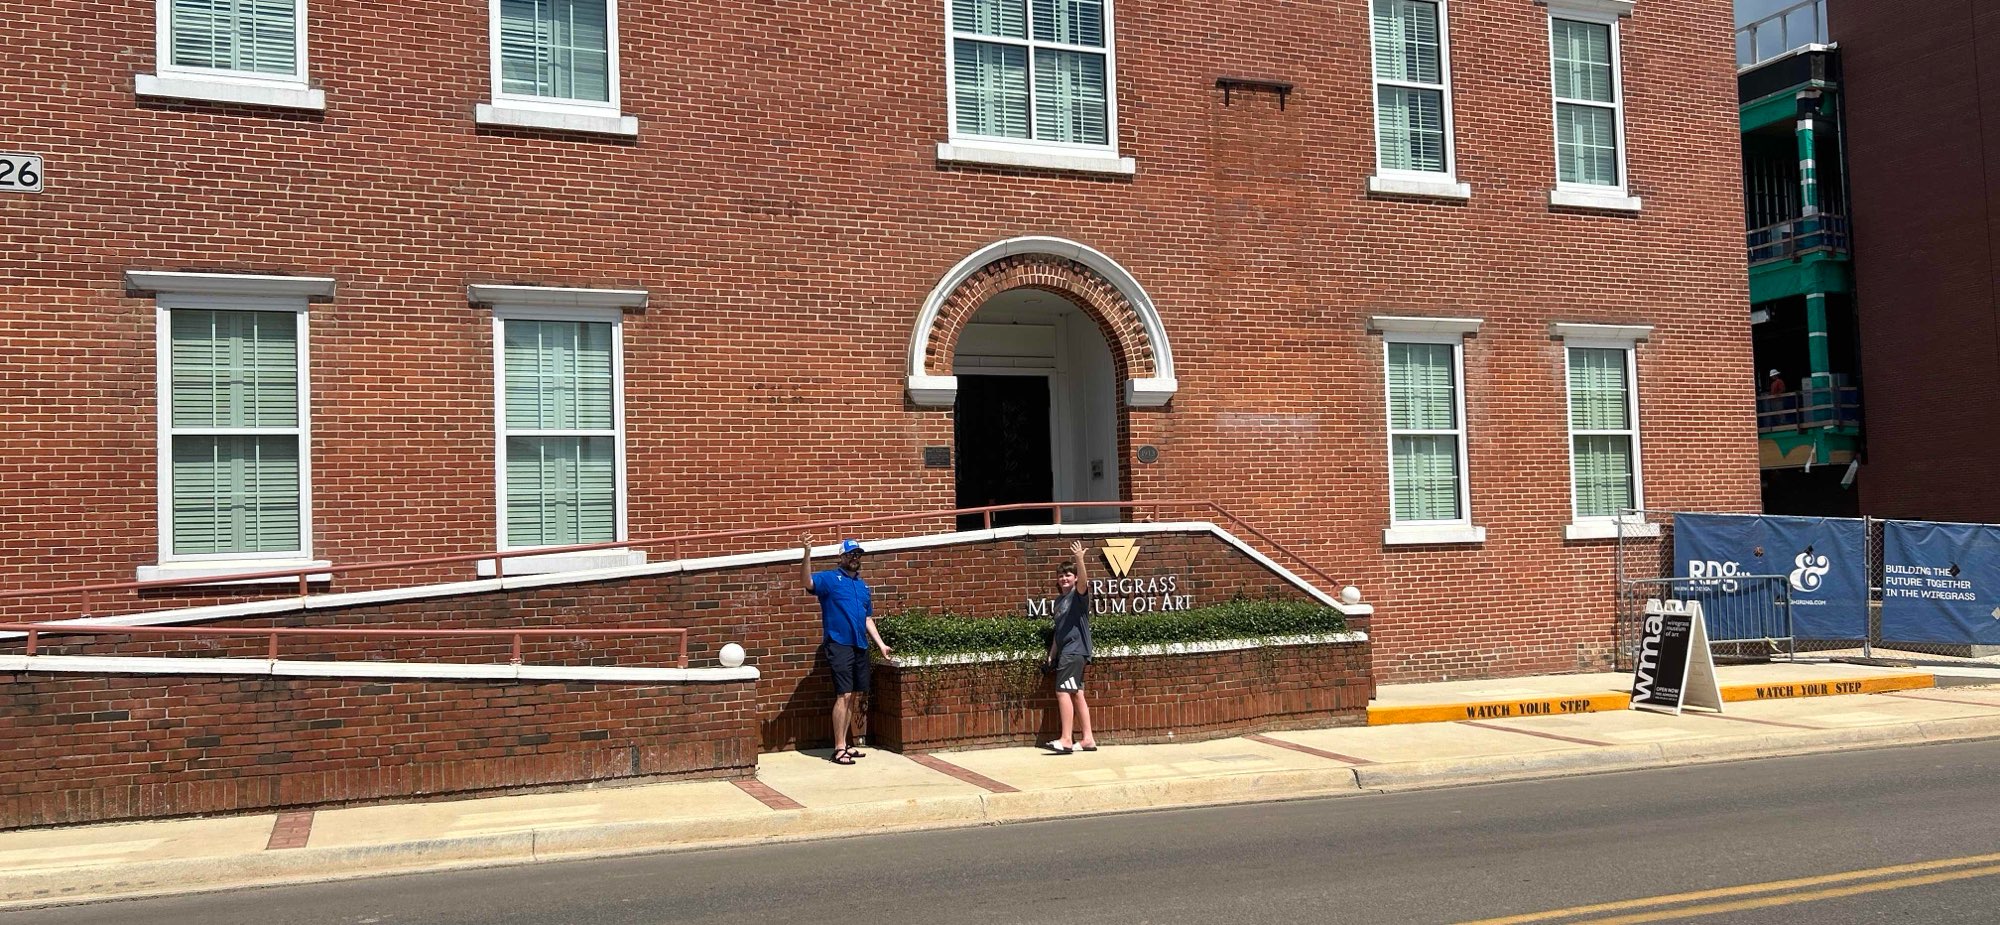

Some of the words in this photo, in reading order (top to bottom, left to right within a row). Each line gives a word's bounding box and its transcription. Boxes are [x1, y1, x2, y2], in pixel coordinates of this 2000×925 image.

[0, 159, 39, 187] 26
[1885, 564, 1932, 576] BUILDING
[1933, 567, 1952, 577] THE
[1087, 576, 1176, 596] REGRASS
[1885, 576, 1923, 587] FUTURE
[1926, 578, 1971, 590] TOGETHER
[1885, 588, 1898, 597] IN
[1900, 589, 1919, 598] THE
[1920, 590, 1976, 601] WIREGRASS
[1027, 598, 1127, 617] MUM
[1132, 596, 1157, 613] OF
[1161, 593, 1193, 611] ART
[1632, 614, 1665, 703] wma
[1755, 685, 1794, 699] WATCH
[1800, 683, 1828, 696] YOUR
[1835, 681, 1862, 693] STEP
[1466, 704, 1510, 718] WATCH
[1519, 702, 1551, 714] YOUR
[1560, 699, 1591, 712] STEP
